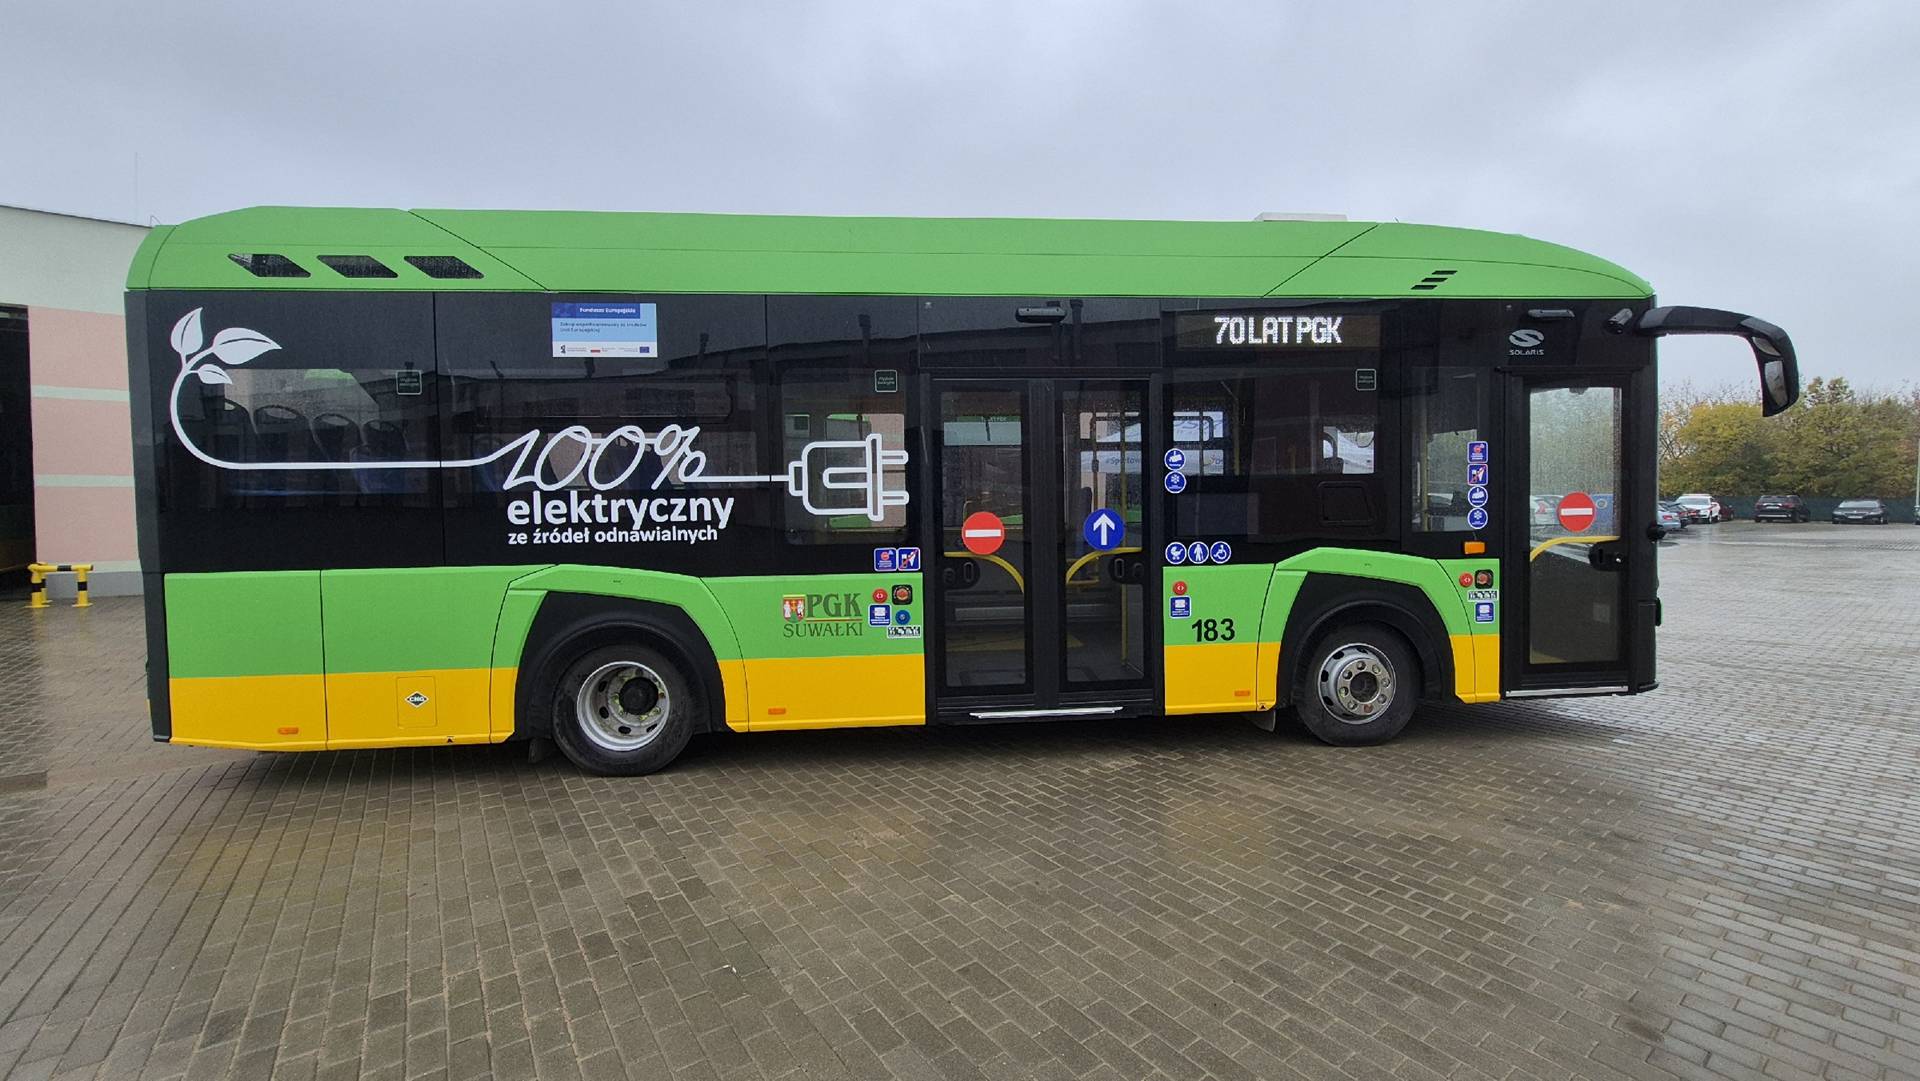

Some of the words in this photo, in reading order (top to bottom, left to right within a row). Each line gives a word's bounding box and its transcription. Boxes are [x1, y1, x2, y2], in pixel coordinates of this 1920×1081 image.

[1214, 316, 1245, 344] 70
[1248, 316, 1293, 344] LAT
[1296, 316, 1342, 344] PGK
[502, 424, 706, 491] 100%
[507, 490, 734, 530] elektryczny
[508, 532, 528, 545] ze
[533, 527, 589, 545] źródeł
[594, 525, 718, 545] odnawialnych
[806, 593, 863, 618] PGK
[783, 622, 863, 638] SUWAŁKI
[1191, 618, 1236, 643] 183
